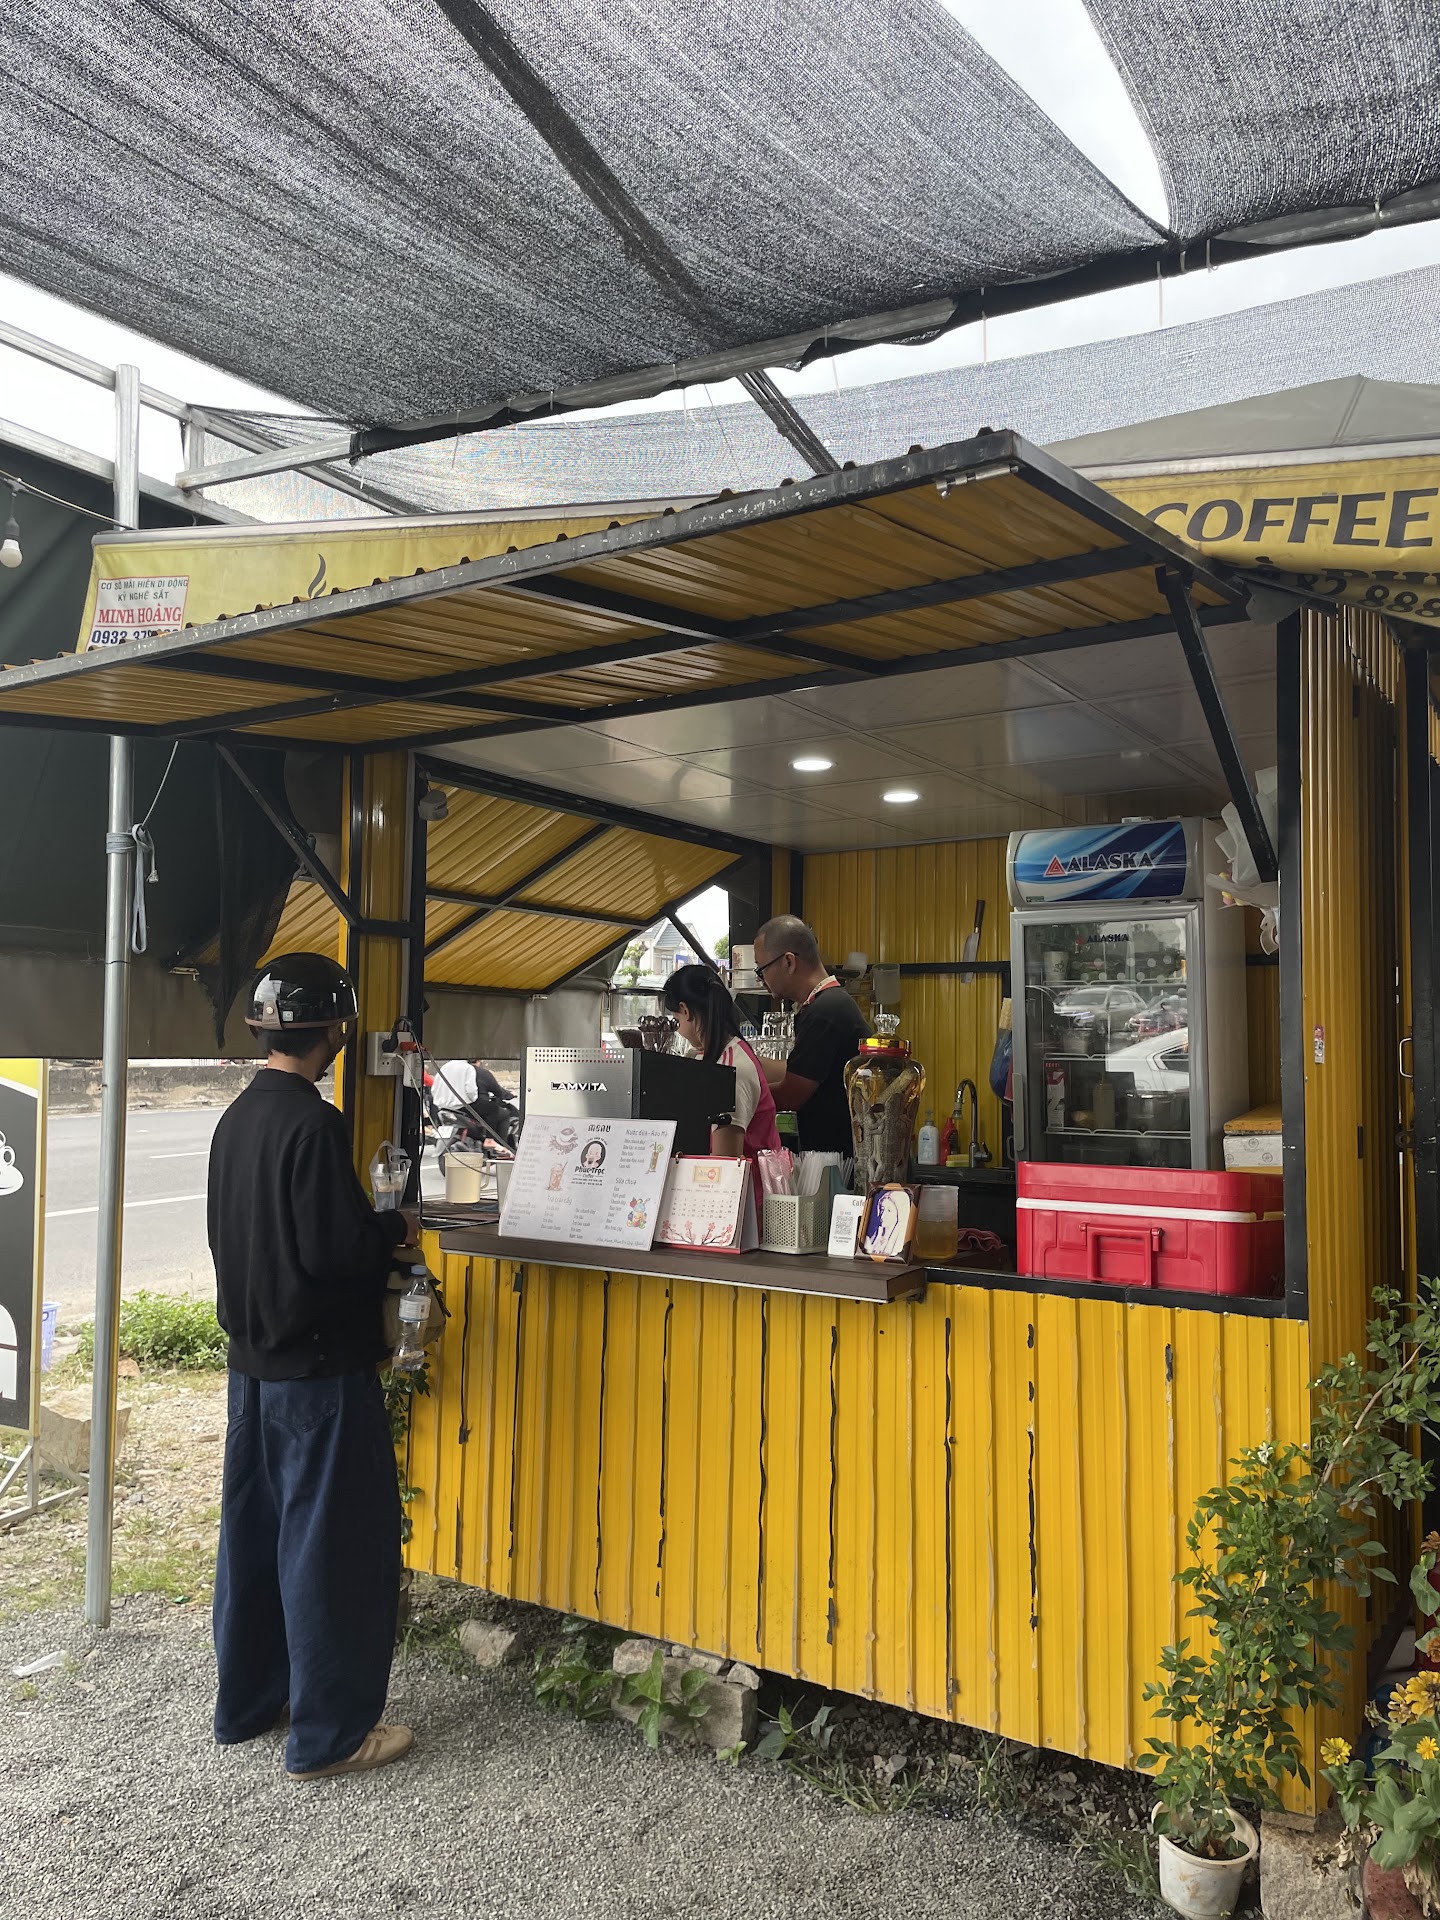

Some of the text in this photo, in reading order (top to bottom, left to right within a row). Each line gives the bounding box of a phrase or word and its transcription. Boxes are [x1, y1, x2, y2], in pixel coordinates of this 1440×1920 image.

[1144, 487, 1439, 548] COFFEE
[157, 579, 166, 588] DI
[97, 603, 182, 623] MINH HOÀNG
[1067, 852, 1155, 872] ALASKA
[1087, 933, 1129, 943] ALASKA
[551, 1082, 607, 1092] LAMVITA
